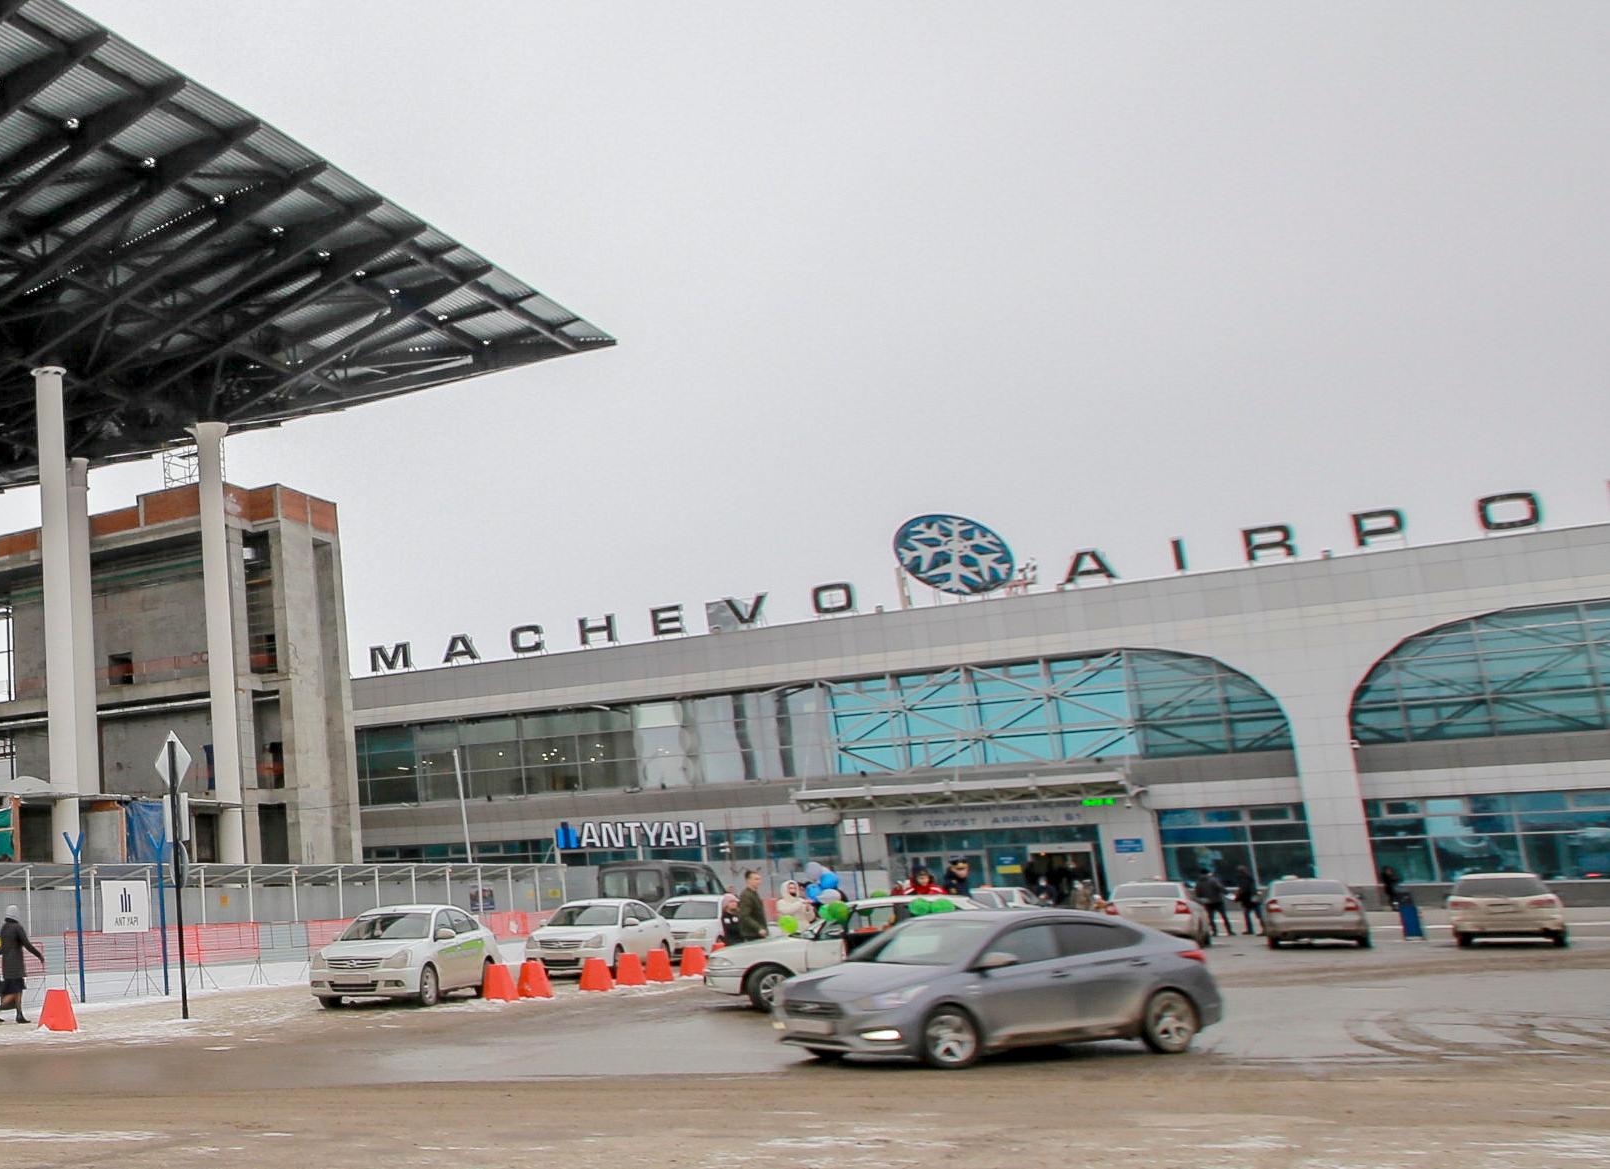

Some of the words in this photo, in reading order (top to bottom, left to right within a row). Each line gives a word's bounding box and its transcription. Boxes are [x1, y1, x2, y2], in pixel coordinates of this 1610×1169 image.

[369, 580, 856, 674] MACHEVO
[1062, 479, 1610, 585] AIRPO
[991, 814, 1051, 825] ARRIVAL
[580, 821, 707, 848] ANTYAPI
[114, 916, 125, 927] ANT
